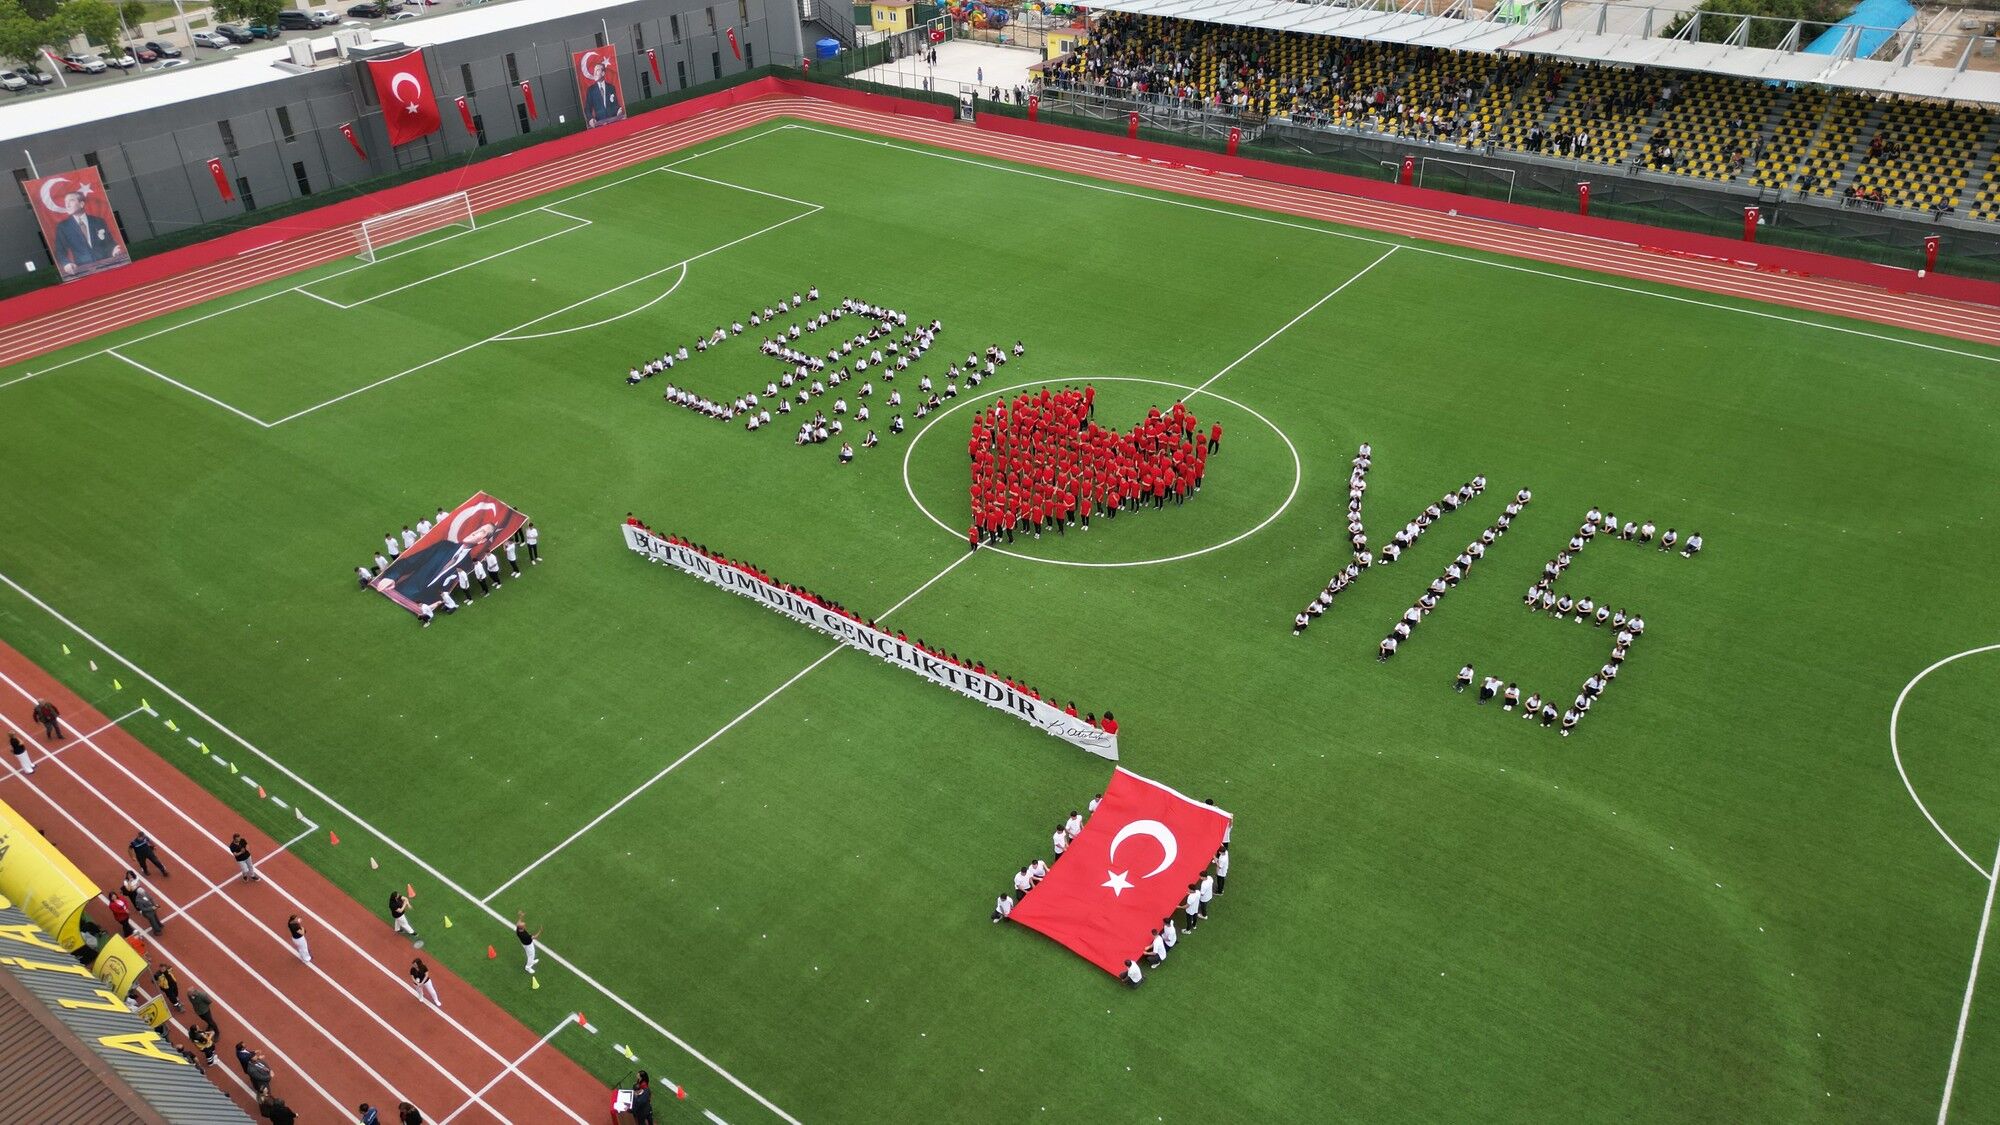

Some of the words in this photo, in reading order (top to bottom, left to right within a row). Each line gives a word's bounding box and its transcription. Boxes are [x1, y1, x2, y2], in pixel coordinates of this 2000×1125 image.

[633, 531, 711, 575] BÜTÜN
[717, 565, 815, 621] ÜMİDİM
[823, 614, 1044, 724] GENÇLİKTEDİR.
